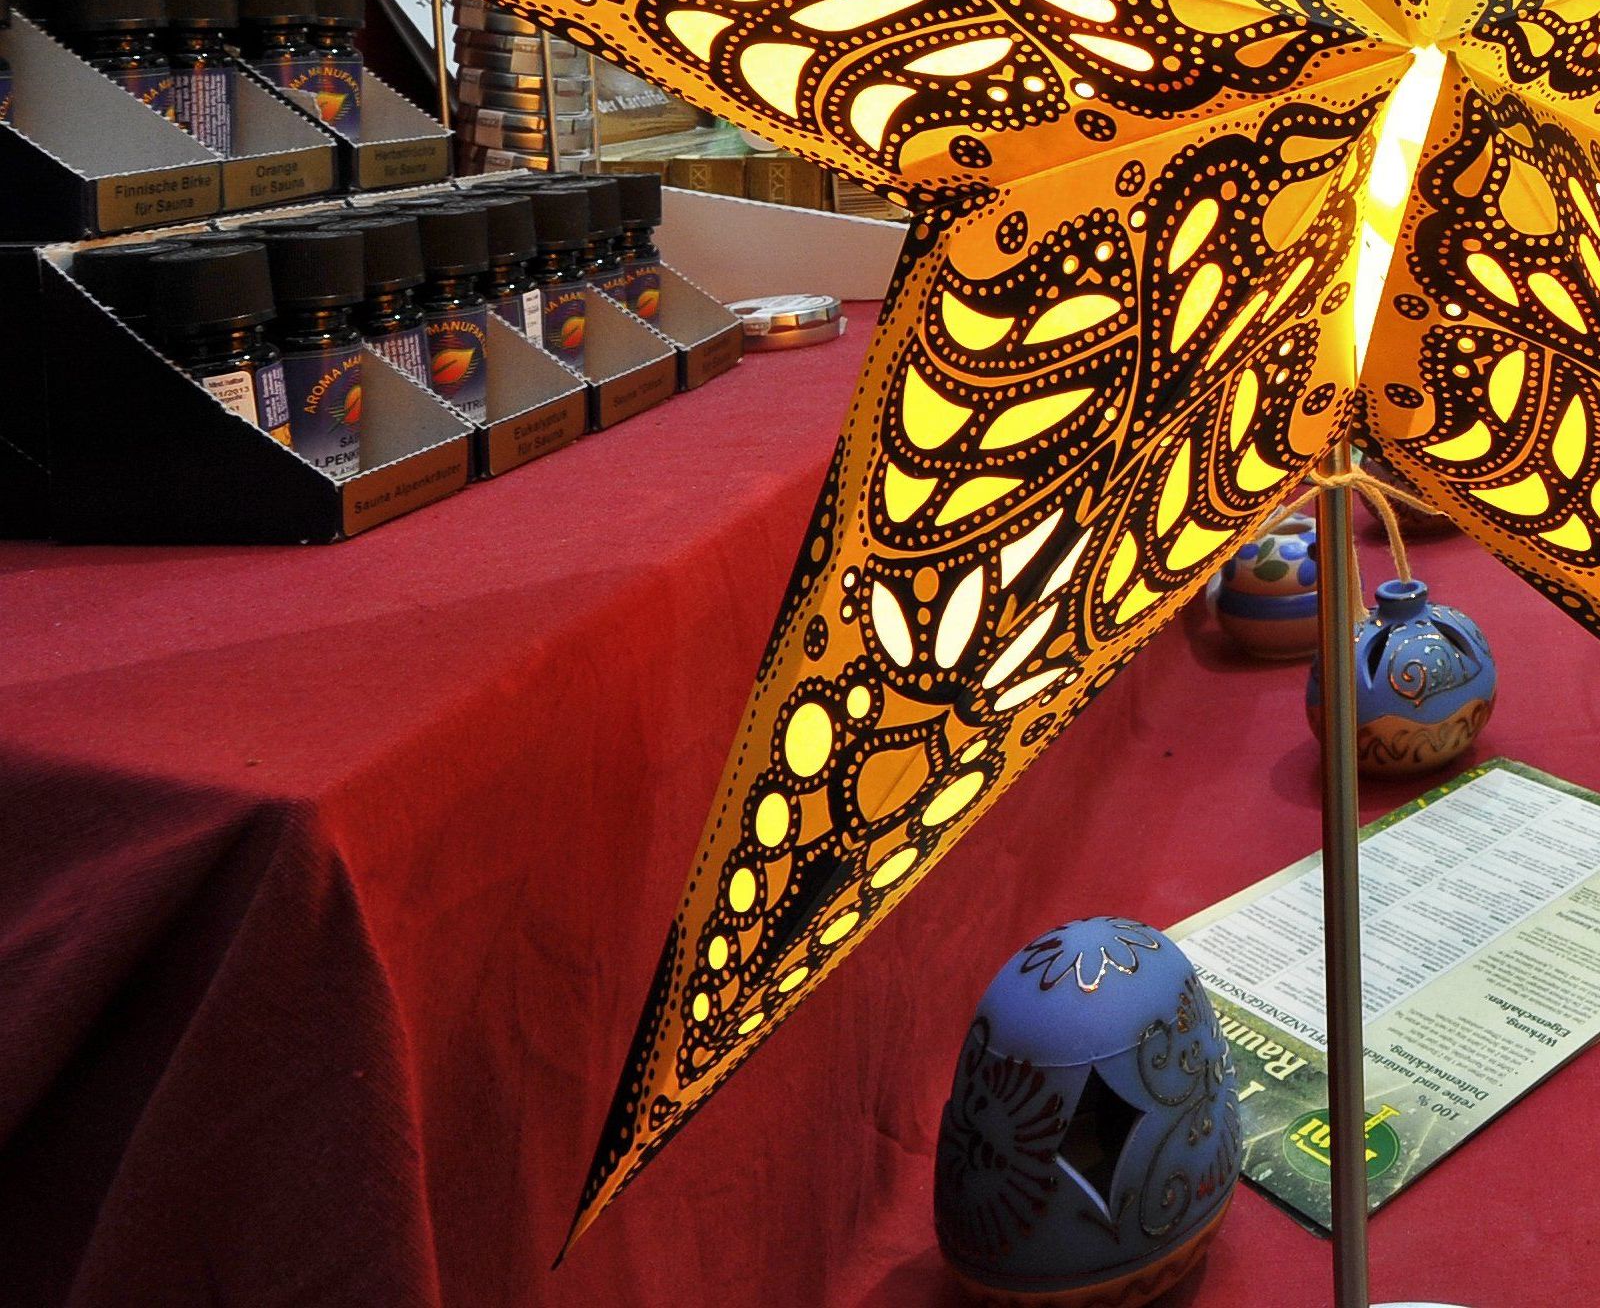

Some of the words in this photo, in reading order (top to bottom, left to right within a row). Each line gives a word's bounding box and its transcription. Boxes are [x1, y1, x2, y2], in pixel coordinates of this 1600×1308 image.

[256, 162, 299, 179] Orange
[114, 180, 180, 198] Finnische
[181, 175, 212, 192] Birke
[269, 178, 305, 195] Sauna
[156, 196, 195, 214] Sauna
[304, 368, 342, 414] AROMA
[354, 491, 391, 515] Sauna
[1193, 963, 1327, 1045] PFLANZENEIGENSCHAFTE
[1484, 994, 1571, 1037] Eigenschaften:
[1506, 1017, 1557, 1047] Wirkung,
[1213, 1009, 1308, 1081] Raum
[1365, 1047, 1416, 1079] natürlich
[1390, 1044, 1489, 1100] Duftentwicklung.
[1413, 1076, 1441, 1091] und
[1416, 1095, 1430, 1106] %
[1442, 1090, 1475, 1109] reine
[1431, 1104, 1460, 1120] 100
